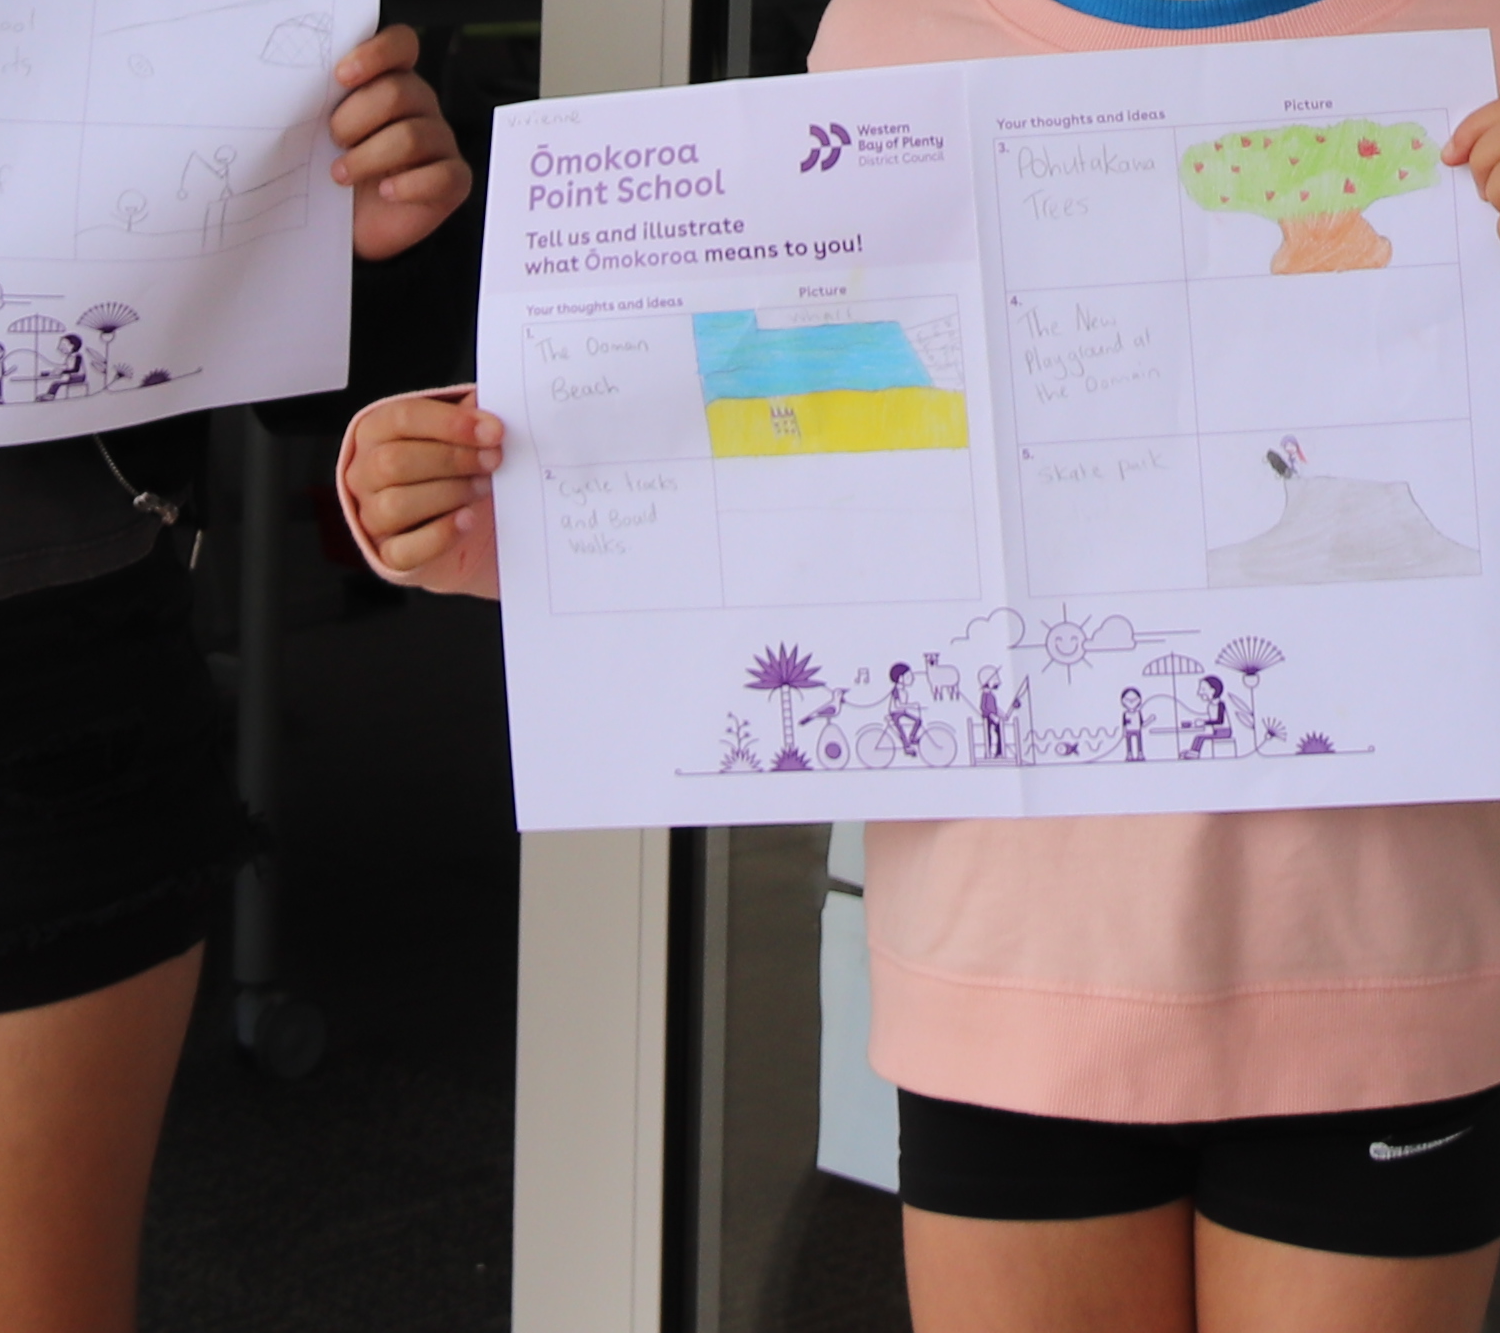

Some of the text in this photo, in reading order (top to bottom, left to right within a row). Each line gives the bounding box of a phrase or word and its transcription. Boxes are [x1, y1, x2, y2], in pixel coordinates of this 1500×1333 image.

[1284, 98, 1333, 111] Picture
[997, 108, 1165, 131] Your thoughts and ideas
[857, 122, 911, 135] Western
[858, 135, 944, 151] Bay of Plenty
[998, 142, 1010, 154] 3.
[530, 143, 699, 177] Ōmokoroa
[858, 151, 944, 166] District Council
[529, 171, 726, 211] Point School
[526, 217, 745, 250] Tell us and illustrate
[525, 234, 863, 275] what Ōmokoroa means to you!
[799, 284, 847, 298] Picture
[526, 295, 683, 316] Your thoughts and ideas
[1010, 295, 1023, 308] 4.
[1022, 449, 1035, 460] 5.
